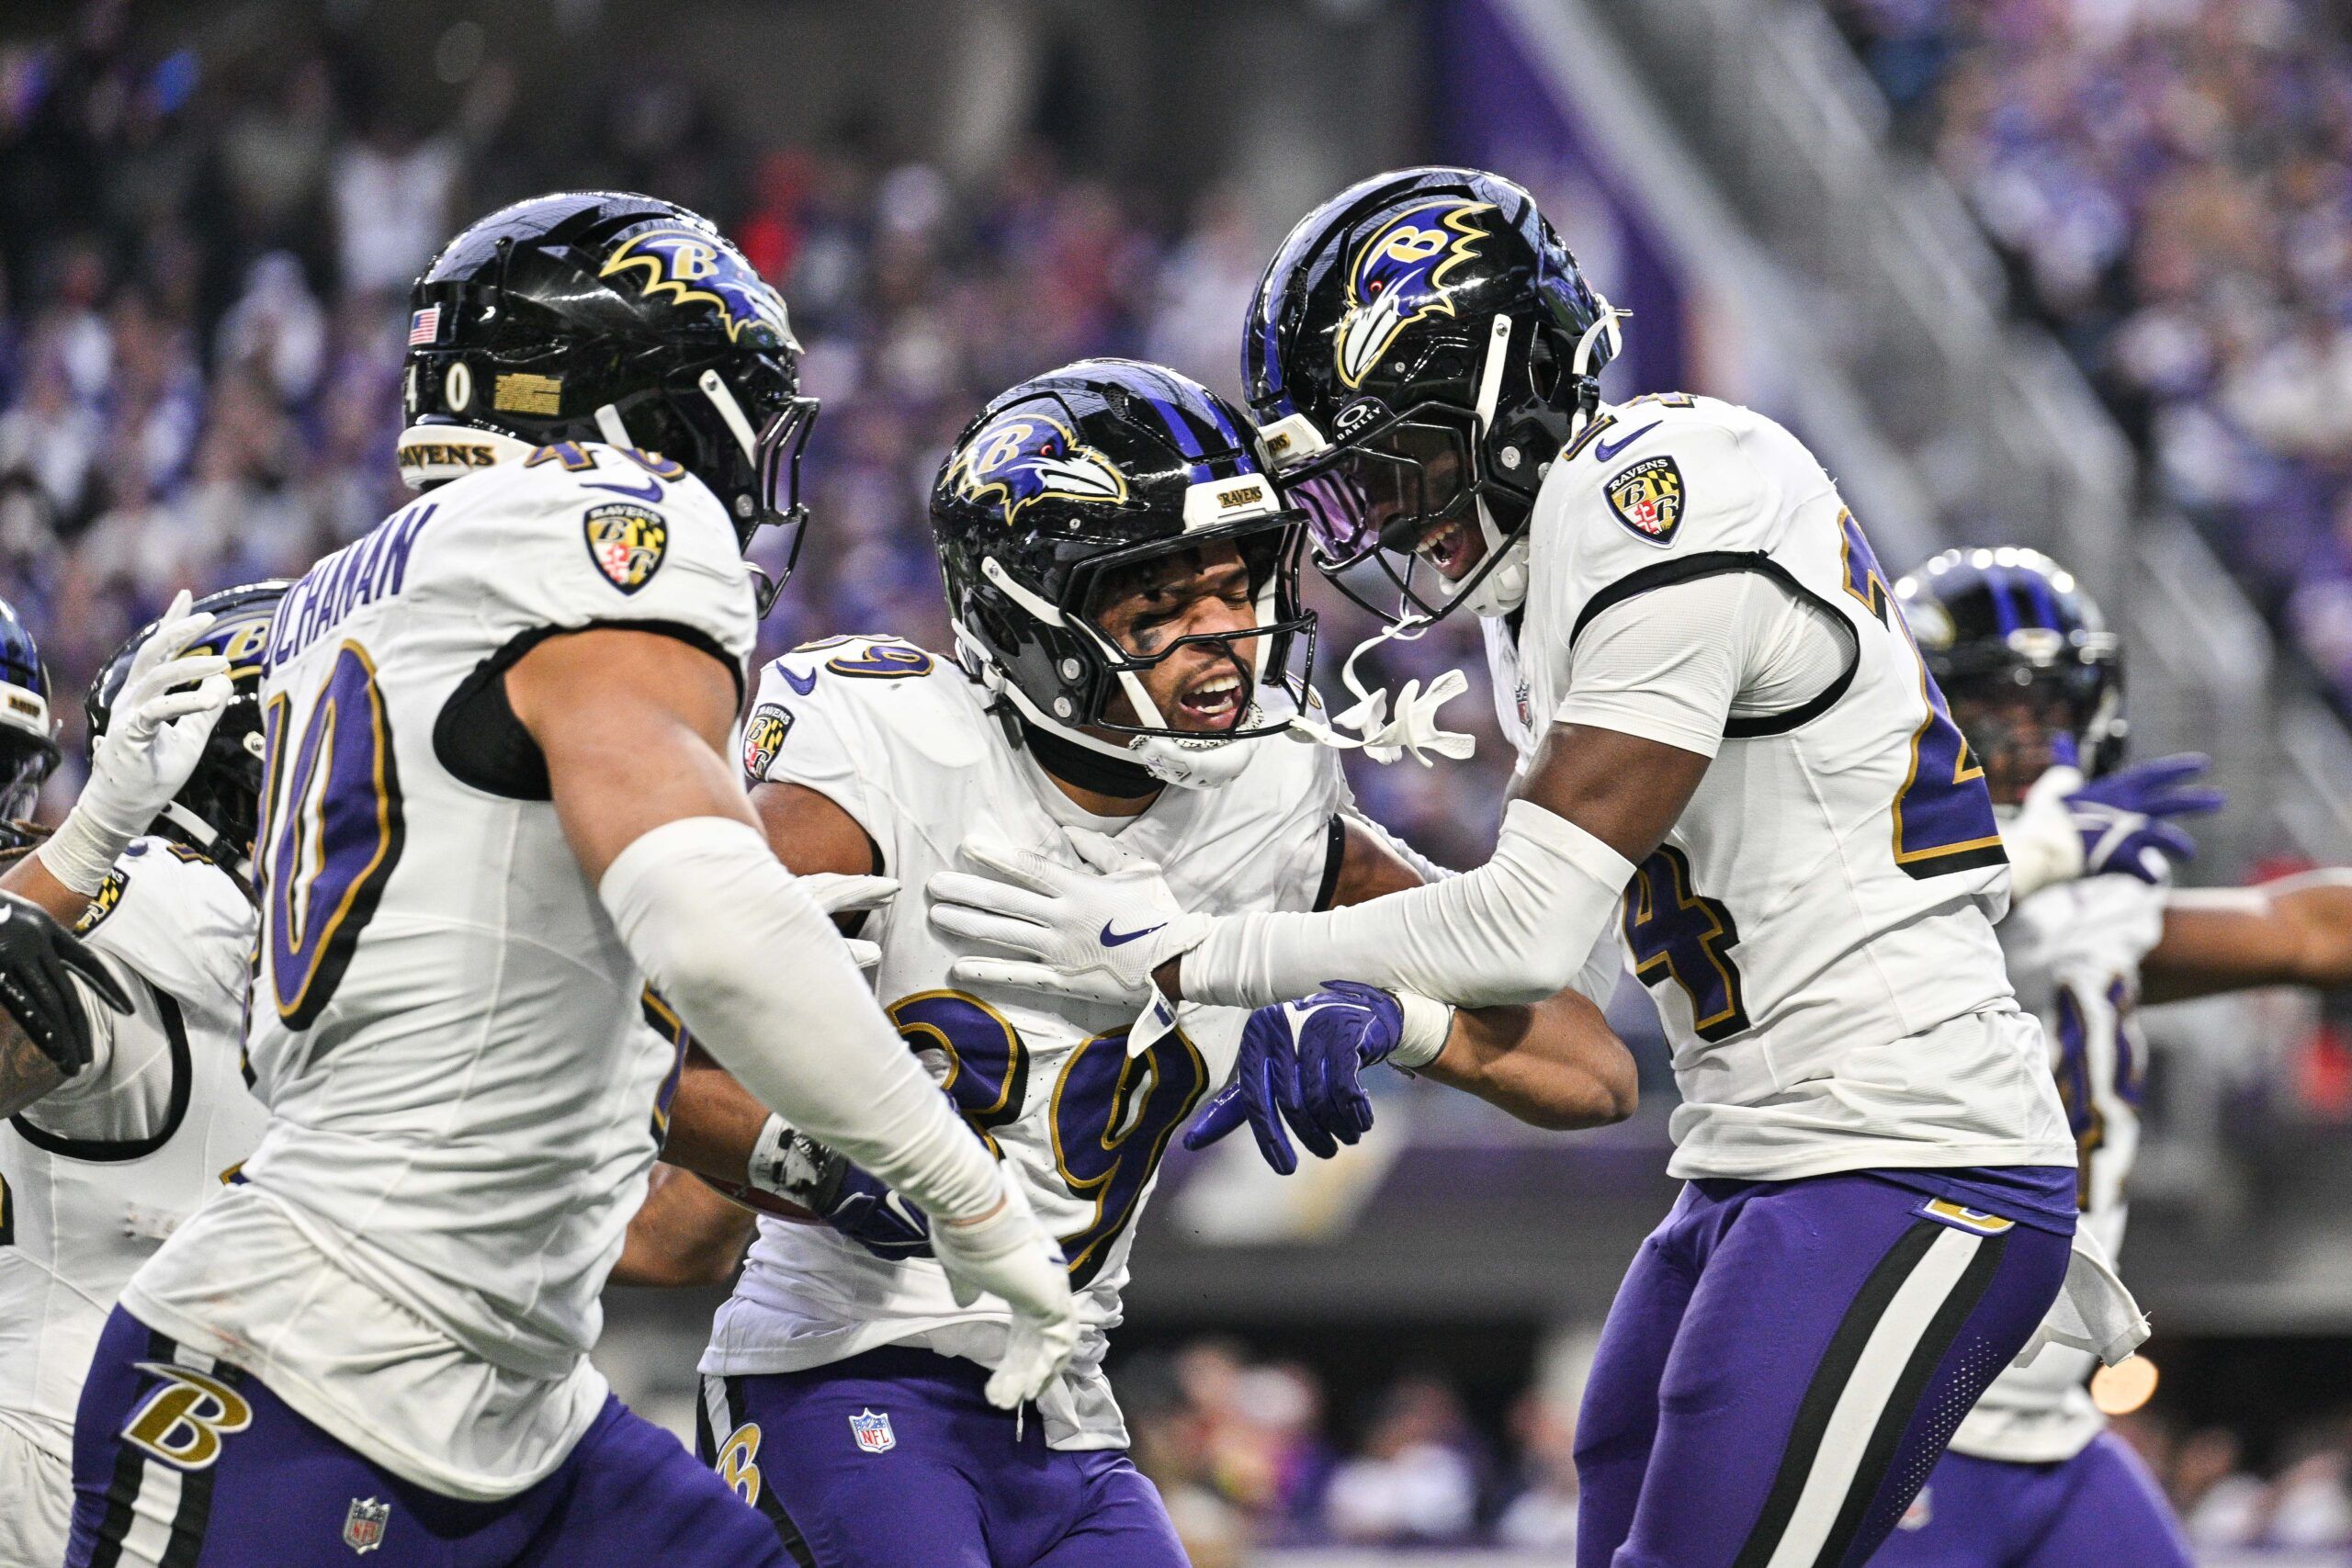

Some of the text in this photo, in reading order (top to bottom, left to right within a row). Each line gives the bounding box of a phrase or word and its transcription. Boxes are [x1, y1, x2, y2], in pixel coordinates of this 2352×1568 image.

[1337, 406, 1381, 441] OAKLEY
[398, 445, 496, 470] AVENS
[1608, 459, 1668, 491] RAVENS
[1217, 486, 1262, 508] RAVENS
[757, 705, 791, 726] RAVENS
[121, 1362, 253, 1470] B
[862, 1428, 889, 1446] NFL
